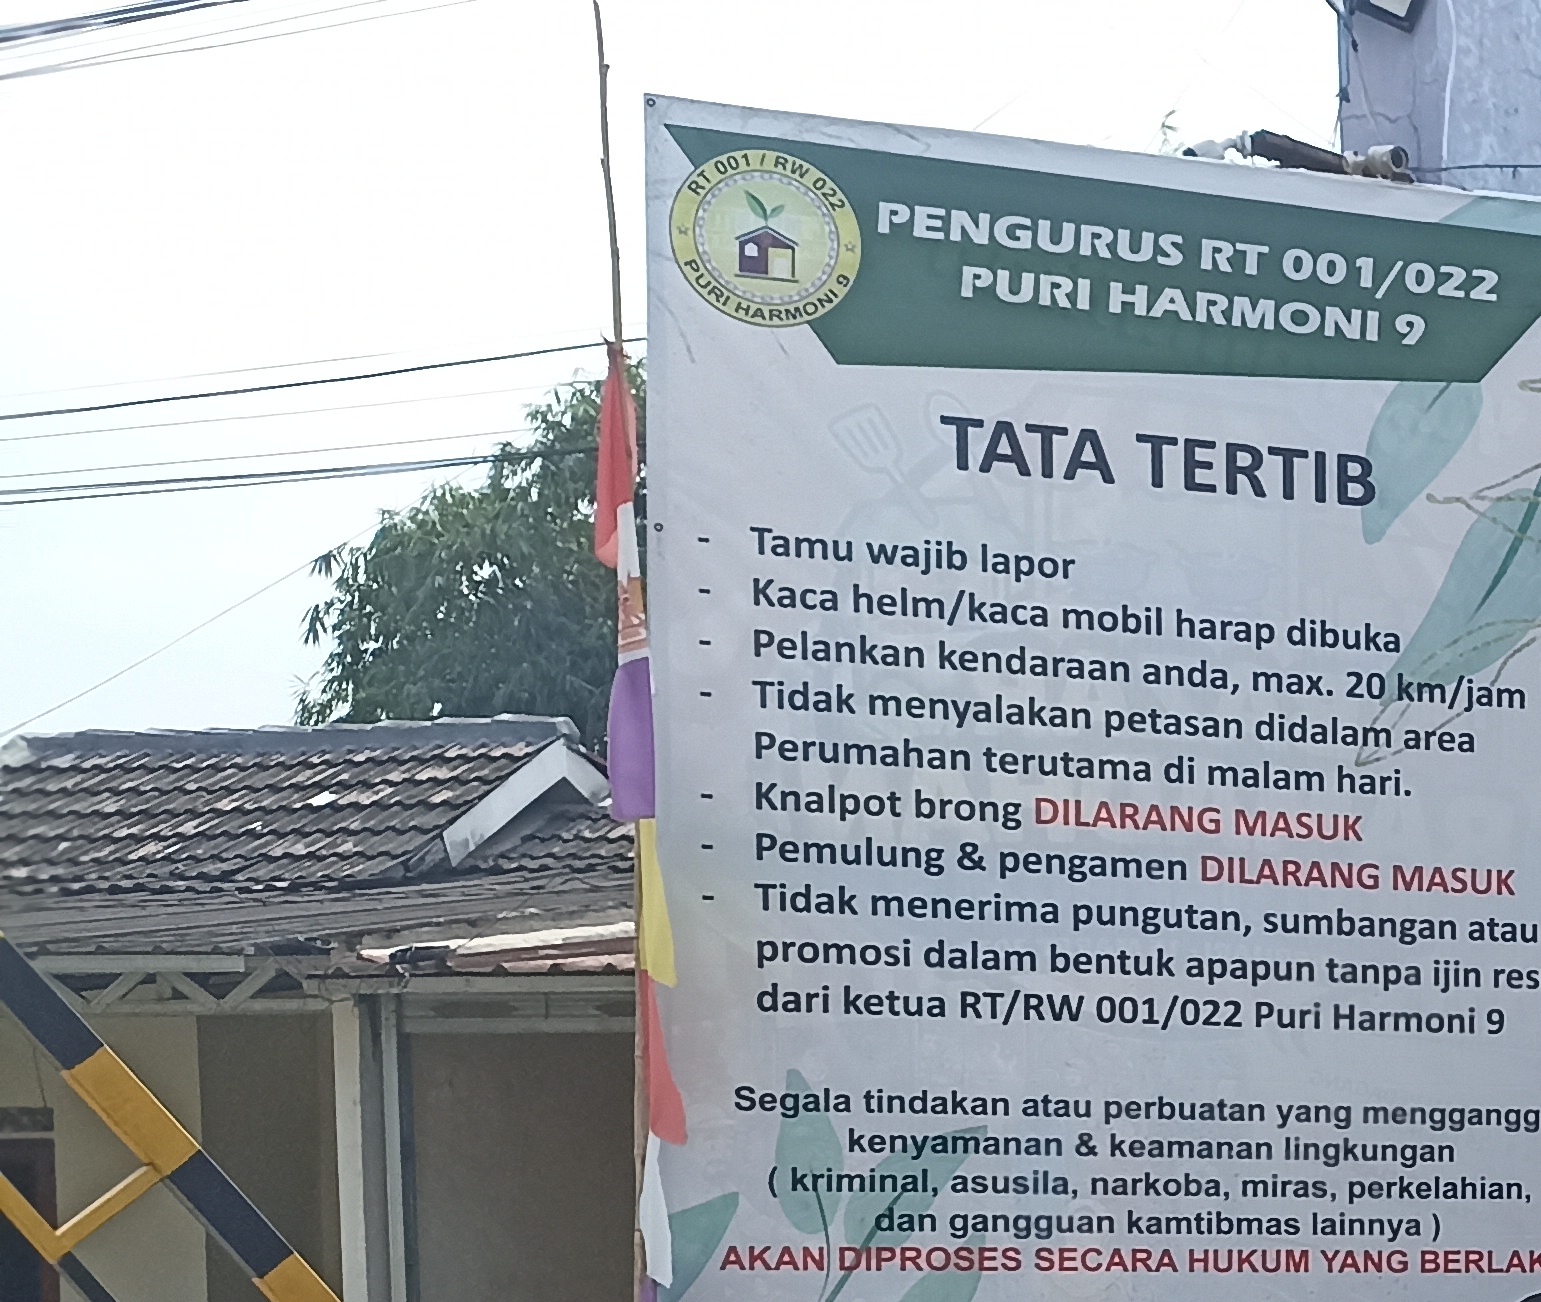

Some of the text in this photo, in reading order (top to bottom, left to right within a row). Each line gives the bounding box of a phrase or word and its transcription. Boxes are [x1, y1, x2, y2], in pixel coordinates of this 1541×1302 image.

[687, 170, 712, 197] RT
[714, 152, 751, 175] 001
[773, 154, 811, 179] RW
[811, 176, 847, 212] 022
[878, 201, 1498, 301] PENGURUS RT 001/022
[684, 258, 851, 323] PURI HARMONI 9
[961, 266, 1425, 344] PURI HARMONI 9
[940, 415, 1376, 506] TATA TERTIB
[750, 527, 852, 562] Tamu
[866, 540, 967, 575] wajib
[981, 544, 1075, 582] lapor
[753, 578, 838, 611] Kaca
[853, 584, 1048, 627] helm/kaca
[1063, 605, 1162, 636] mobil
[1176, 609, 1274, 650] harap
[1287, 618, 1400, 653] dibuka
[754, 629, 924, 668] Pelankan
[939, 640, 1129, 682] kendaraan
[1143, 660, 1239, 695] anda,
[1253, 672, 1333, 696] max.
[1346, 672, 1385, 699] 20
[1397, 673, 1525, 712] km/jam
[752, 681, 855, 714] Tidak
[869, 694, 1091, 729] menyalakan
[1105, 709, 1242, 739] petasan
[1256, 713, 1391, 748] didalam
[1404, 730, 1474, 752] area
[755, 732, 1411, 796] Perumahan terutama di malam hari.
[756, 782, 901, 821] Knalpot
[915, 789, 1021, 830] brong
[1035, 797, 1222, 835] DILARANG
[1234, 810, 1360, 841] MASUK
[756, 833, 944, 876] Pemulung
[957, 842, 986, 871] &
[1000, 852, 1186, 882] pengamen
[1200, 856, 1381, 890] DILARANG
[1393, 865, 1514, 895] MASUK
[754, 883, 858, 915] Tidak
[872, 893, 1058, 923] menerima
[1073, 904, 1251, 937] pungutan,
[1264, 908, 1456, 945] sumbangan
[1469, 918, 1537, 943] atau
[757, 939, 910, 969] promosi
[924, 939, 1036, 971] dalam
[1050, 944, 1175, 977] bentuk
[1186, 958, 1314, 986] apapun
[1326, 958, 1421, 991] tanpa
[1434, 960, 1480, 993] ijin
[757, 983, 1504, 1034] dari ketua RT/RW 001/022 Puri Harmoni 9
[735, 1086, 851, 1118] Segala
[863, 1089, 1009, 1116] tindakan
[1022, 1095, 1091, 1118] atau
[1105, 1096, 1265, 1124] perbuatan
[1276, 1105, 1351, 1129] yang
[849, 1128, 1454, 1168] kenyamanan & keamanan lingkungan
[791, 1167, 938, 1197] kriminal,
[951, 1170, 1077, 1199] asusila,
[1091, 1172, 1229, 1200] narkoba,
[1242, 1174, 1336, 1201] miras,
[1349, 1176, 1530, 1204] perkelahian,
[874, 1206, 938, 1233] dan
[949, 1214, 1114, 1239] gangguan
[1128, 1210, 1300, 1235] kamtibmas
[1313, 1212, 1421, 1242] lainnya
[722, 1247, 826, 1271] AKAN
[837, 1246, 1023, 1272] DIPROSES
[1036, 1247, 1177, 1272] SECARA
[1188, 1249, 1311, 1274] HUKUM
[1322, 1250, 1409, 1273] YANG
